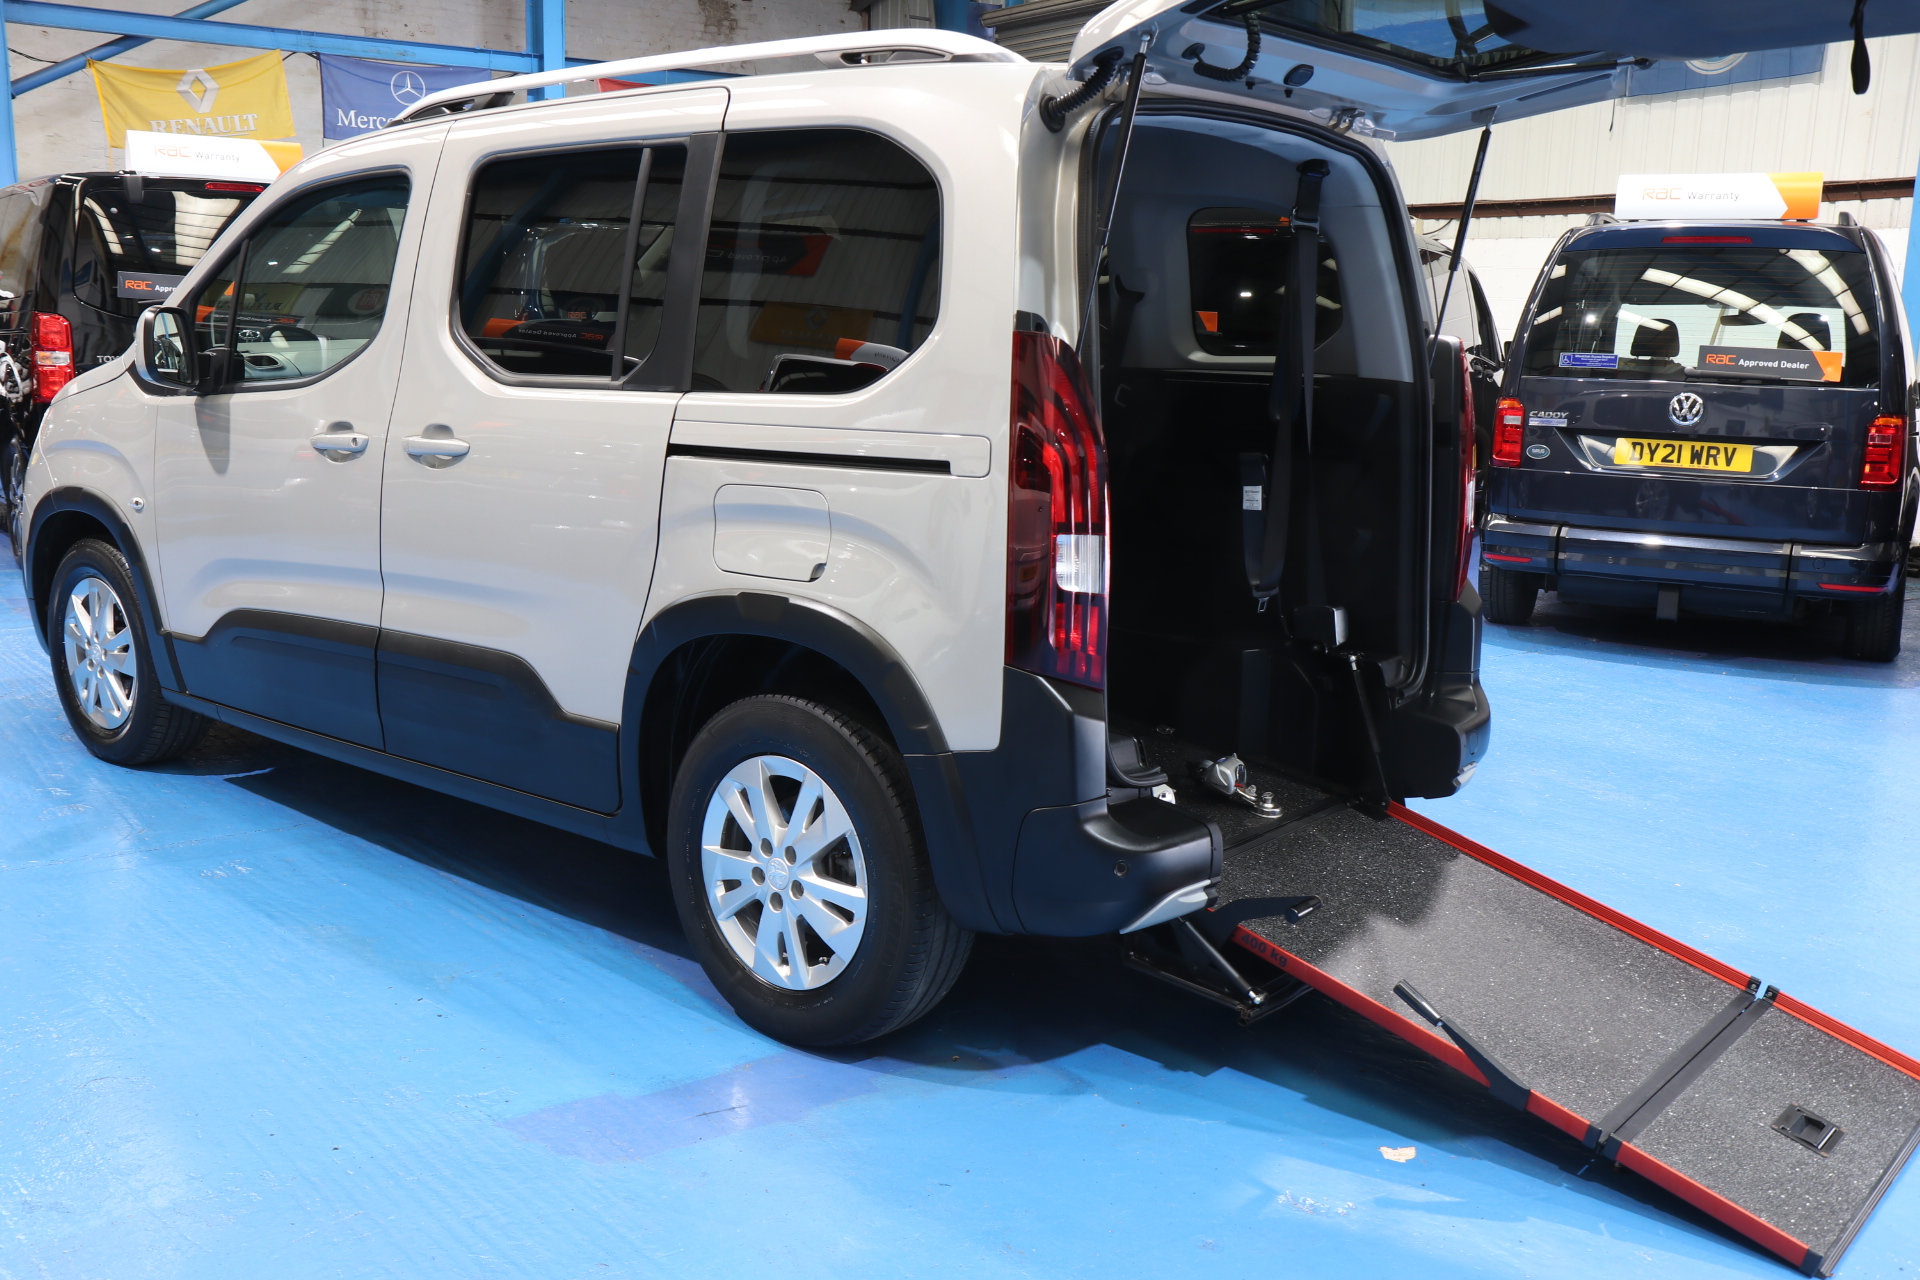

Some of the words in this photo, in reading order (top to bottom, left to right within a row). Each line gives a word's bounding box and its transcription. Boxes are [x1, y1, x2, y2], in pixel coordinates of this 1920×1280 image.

[149, 113, 258, 135] RENAULT
[195, 151, 241, 164] Warranty
[1687, 191, 1741, 202] Warranty
[125, 279, 153, 291] RAC
[1705, 353, 1737, 365] RAC
[1738, 358, 1779, 368] Approved
[1780, 360, 1810, 370] Dealer
[1529, 410, 1569, 419] CADDY
[1629, 441, 1683, 464] DY21
[1690, 445, 1738, 467] WRV
[1241, 933, 1267, 954] 400
[1270, 948, 1289, 968] kg
